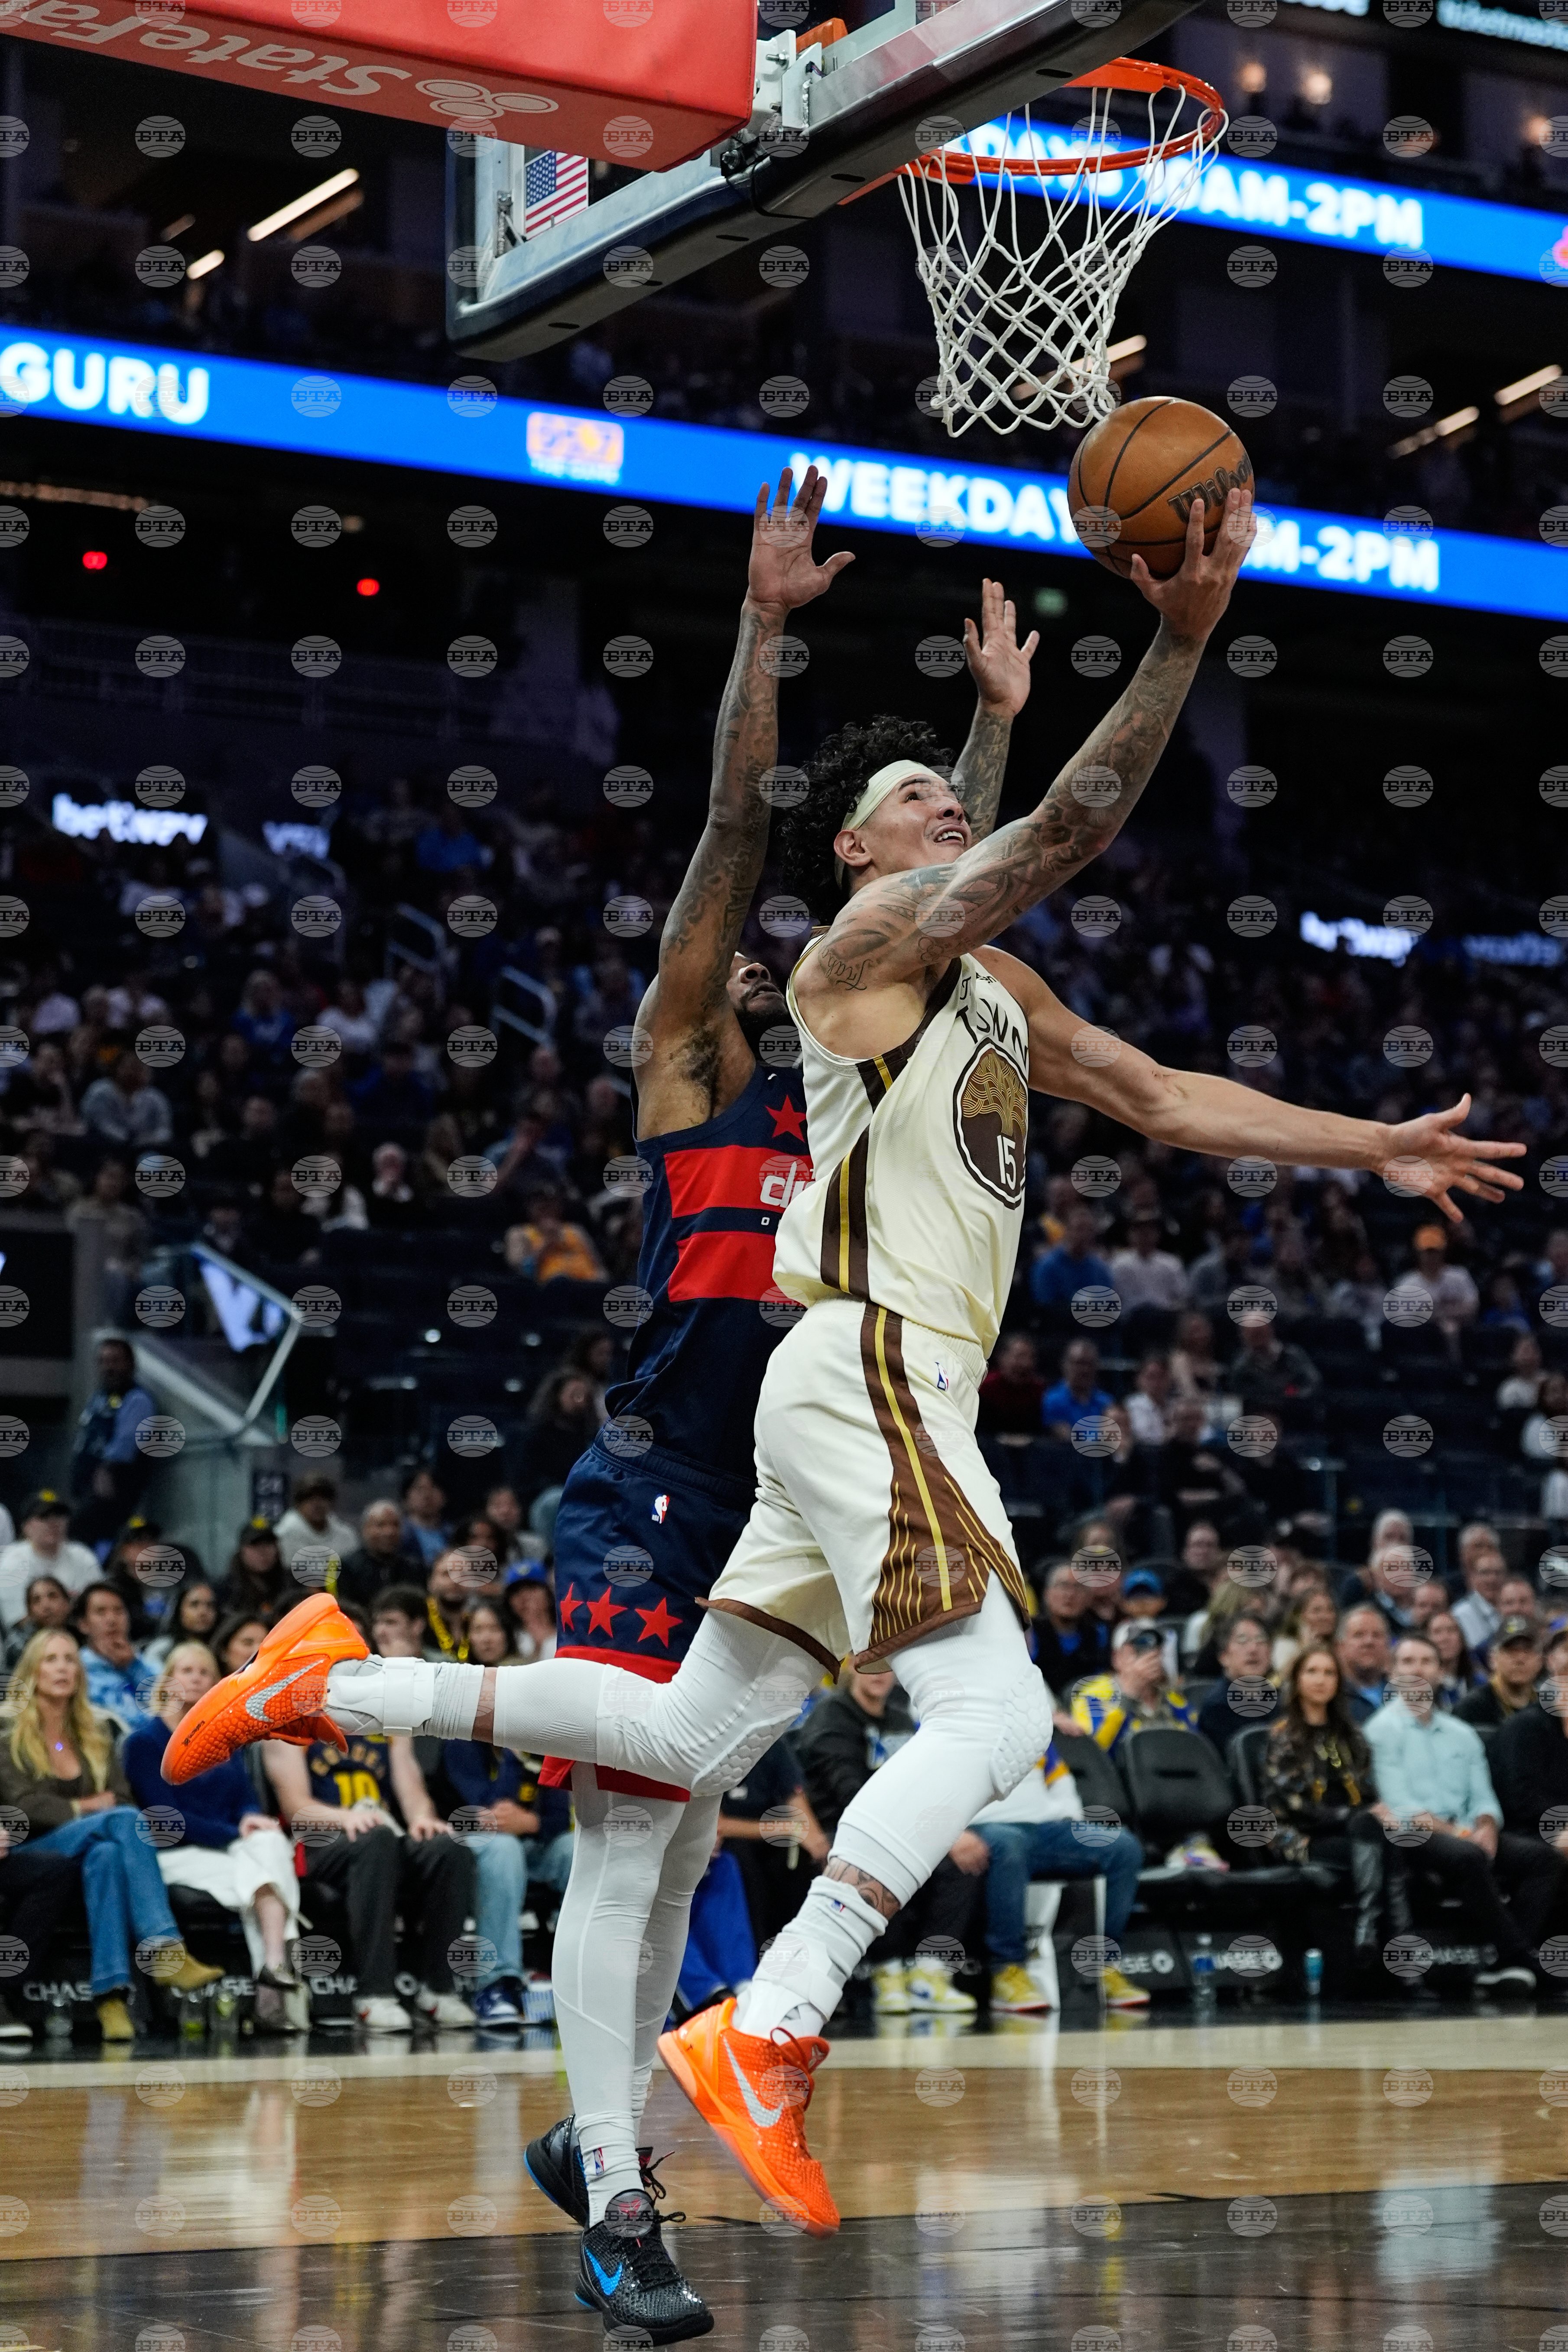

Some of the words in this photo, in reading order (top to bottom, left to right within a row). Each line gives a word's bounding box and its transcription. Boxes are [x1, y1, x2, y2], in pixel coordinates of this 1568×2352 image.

[0, 342, 209, 425] GURU
[789, 452, 1083, 543] WEEKDAY
[997, 1134, 1016, 1191] 15
[333, 1769, 380, 1810] 10
[23, 1980, 93, 2002] CHAS
